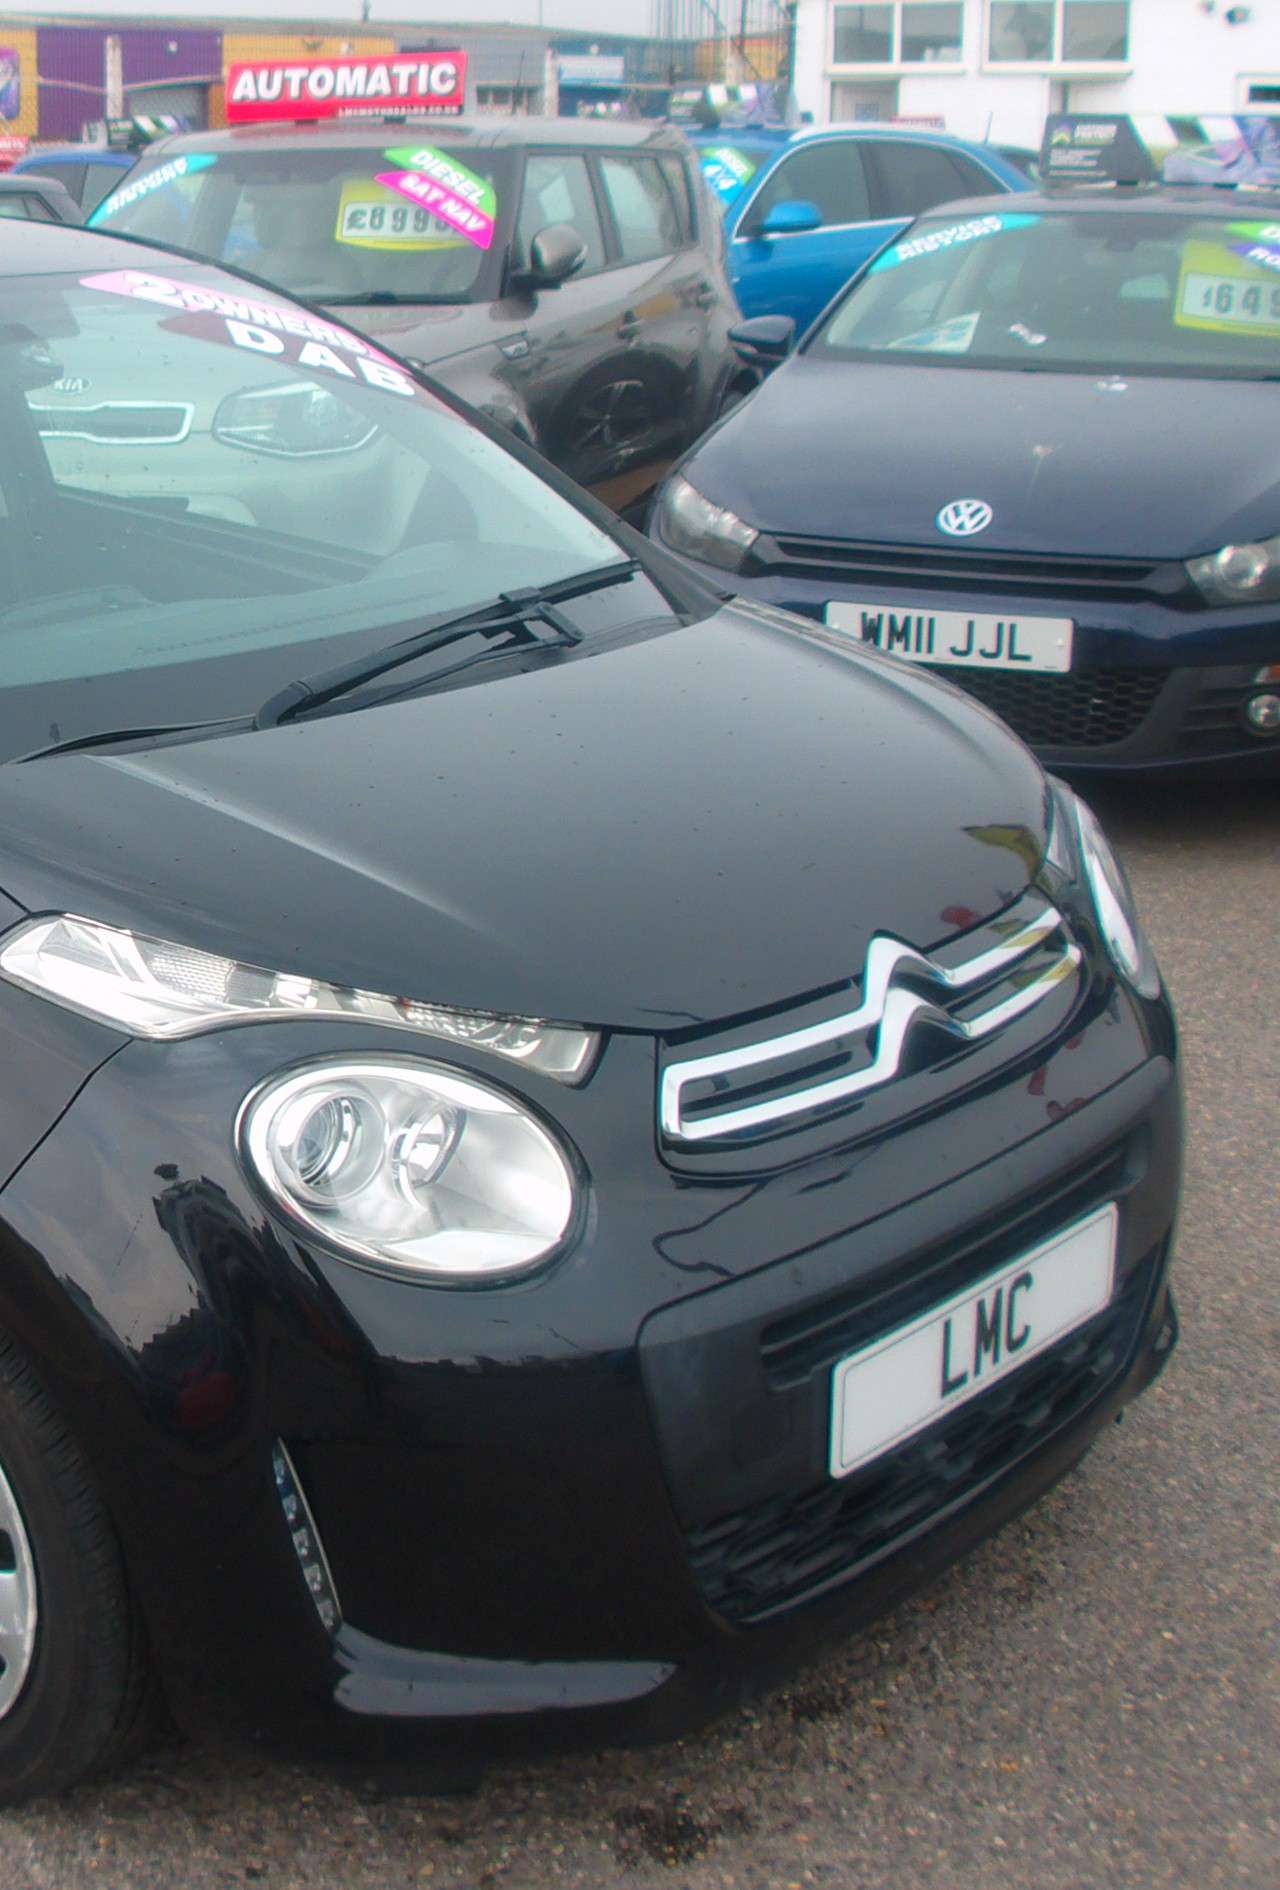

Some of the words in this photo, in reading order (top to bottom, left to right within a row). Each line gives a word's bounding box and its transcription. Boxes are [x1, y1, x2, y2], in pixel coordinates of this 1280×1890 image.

[232, 62, 457, 101] AUTOMATIC
[398, 173, 447, 204] SAT
[439, 198, 487, 232] NAV
[409, 149, 485, 206] DIESEL
[181, 288, 369, 356] OWNERS
[225, 318, 416, 397] DAB
[861, 611, 936, 655] WM11
[949, 619, 1033, 662] JJL
[940, 1271, 1033, 1398] LMC
